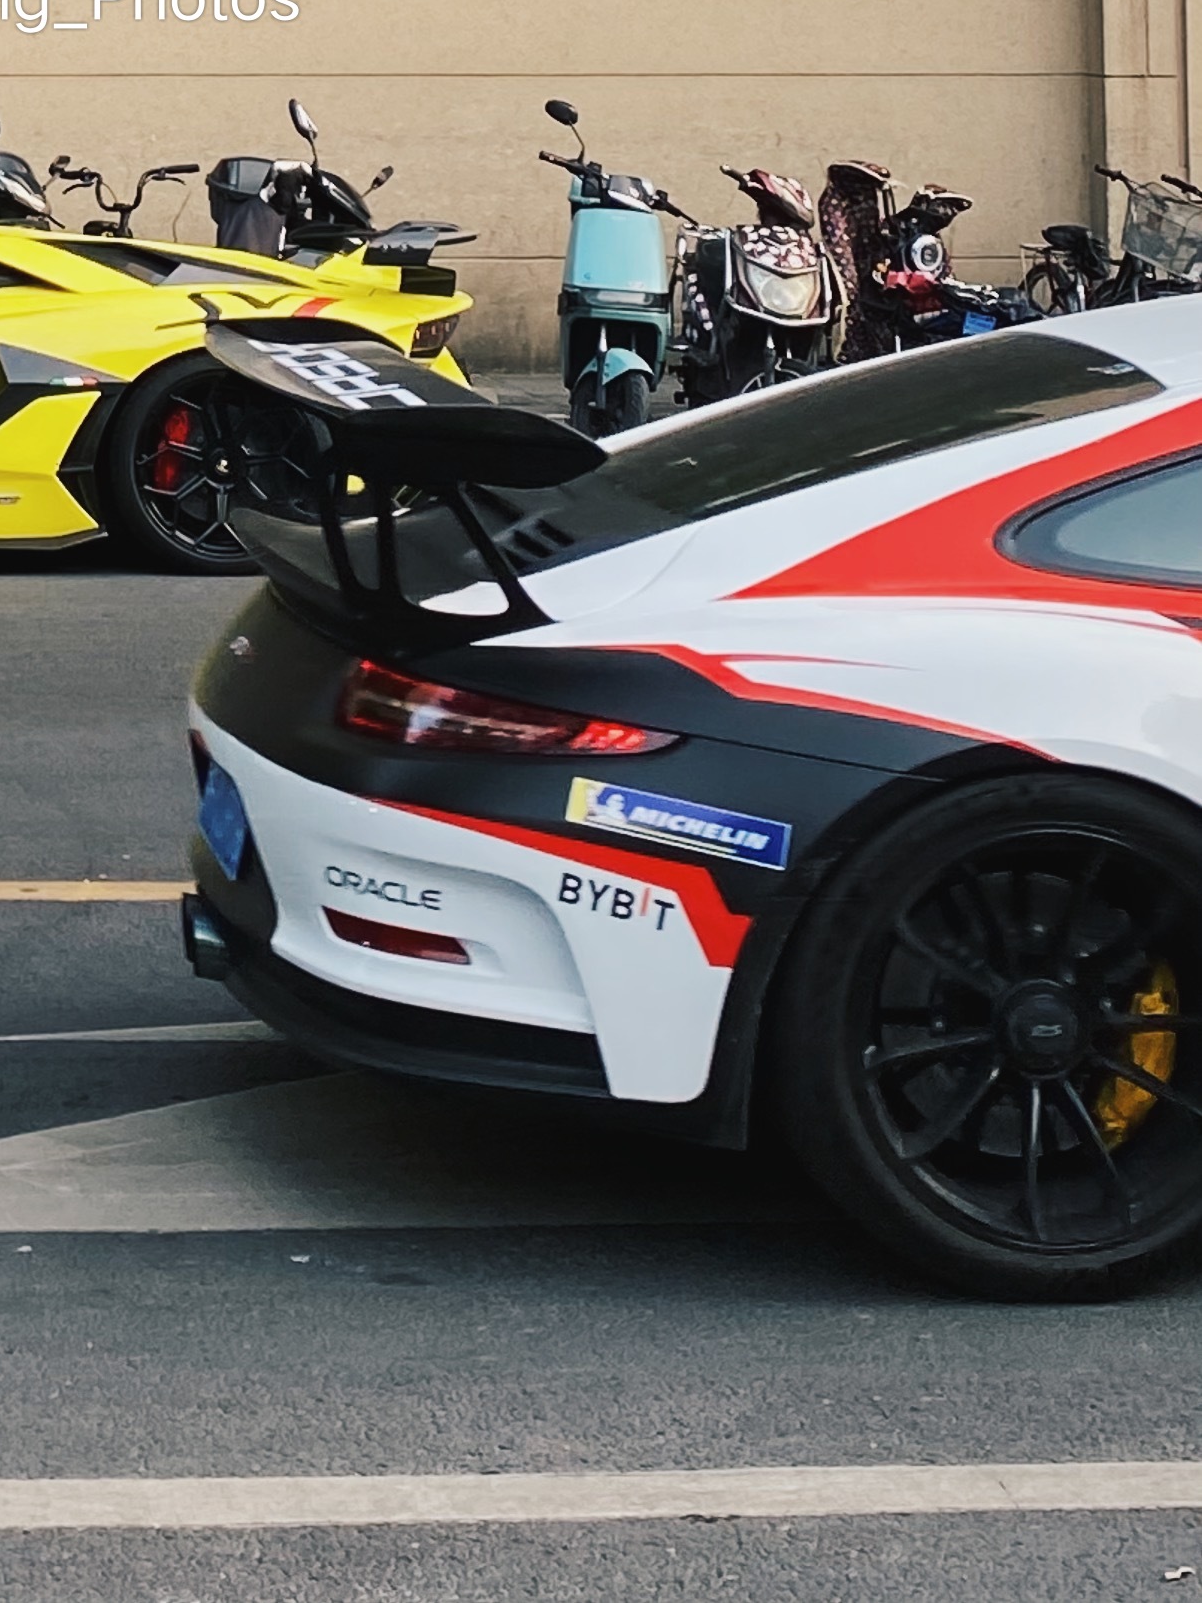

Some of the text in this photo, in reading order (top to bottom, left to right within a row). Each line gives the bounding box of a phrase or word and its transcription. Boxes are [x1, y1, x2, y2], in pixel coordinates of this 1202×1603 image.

[627, 806, 771, 851] MICHELIN
[323, 865, 443, 911] ORACLE
[558, 871, 677, 931] BYBIT
